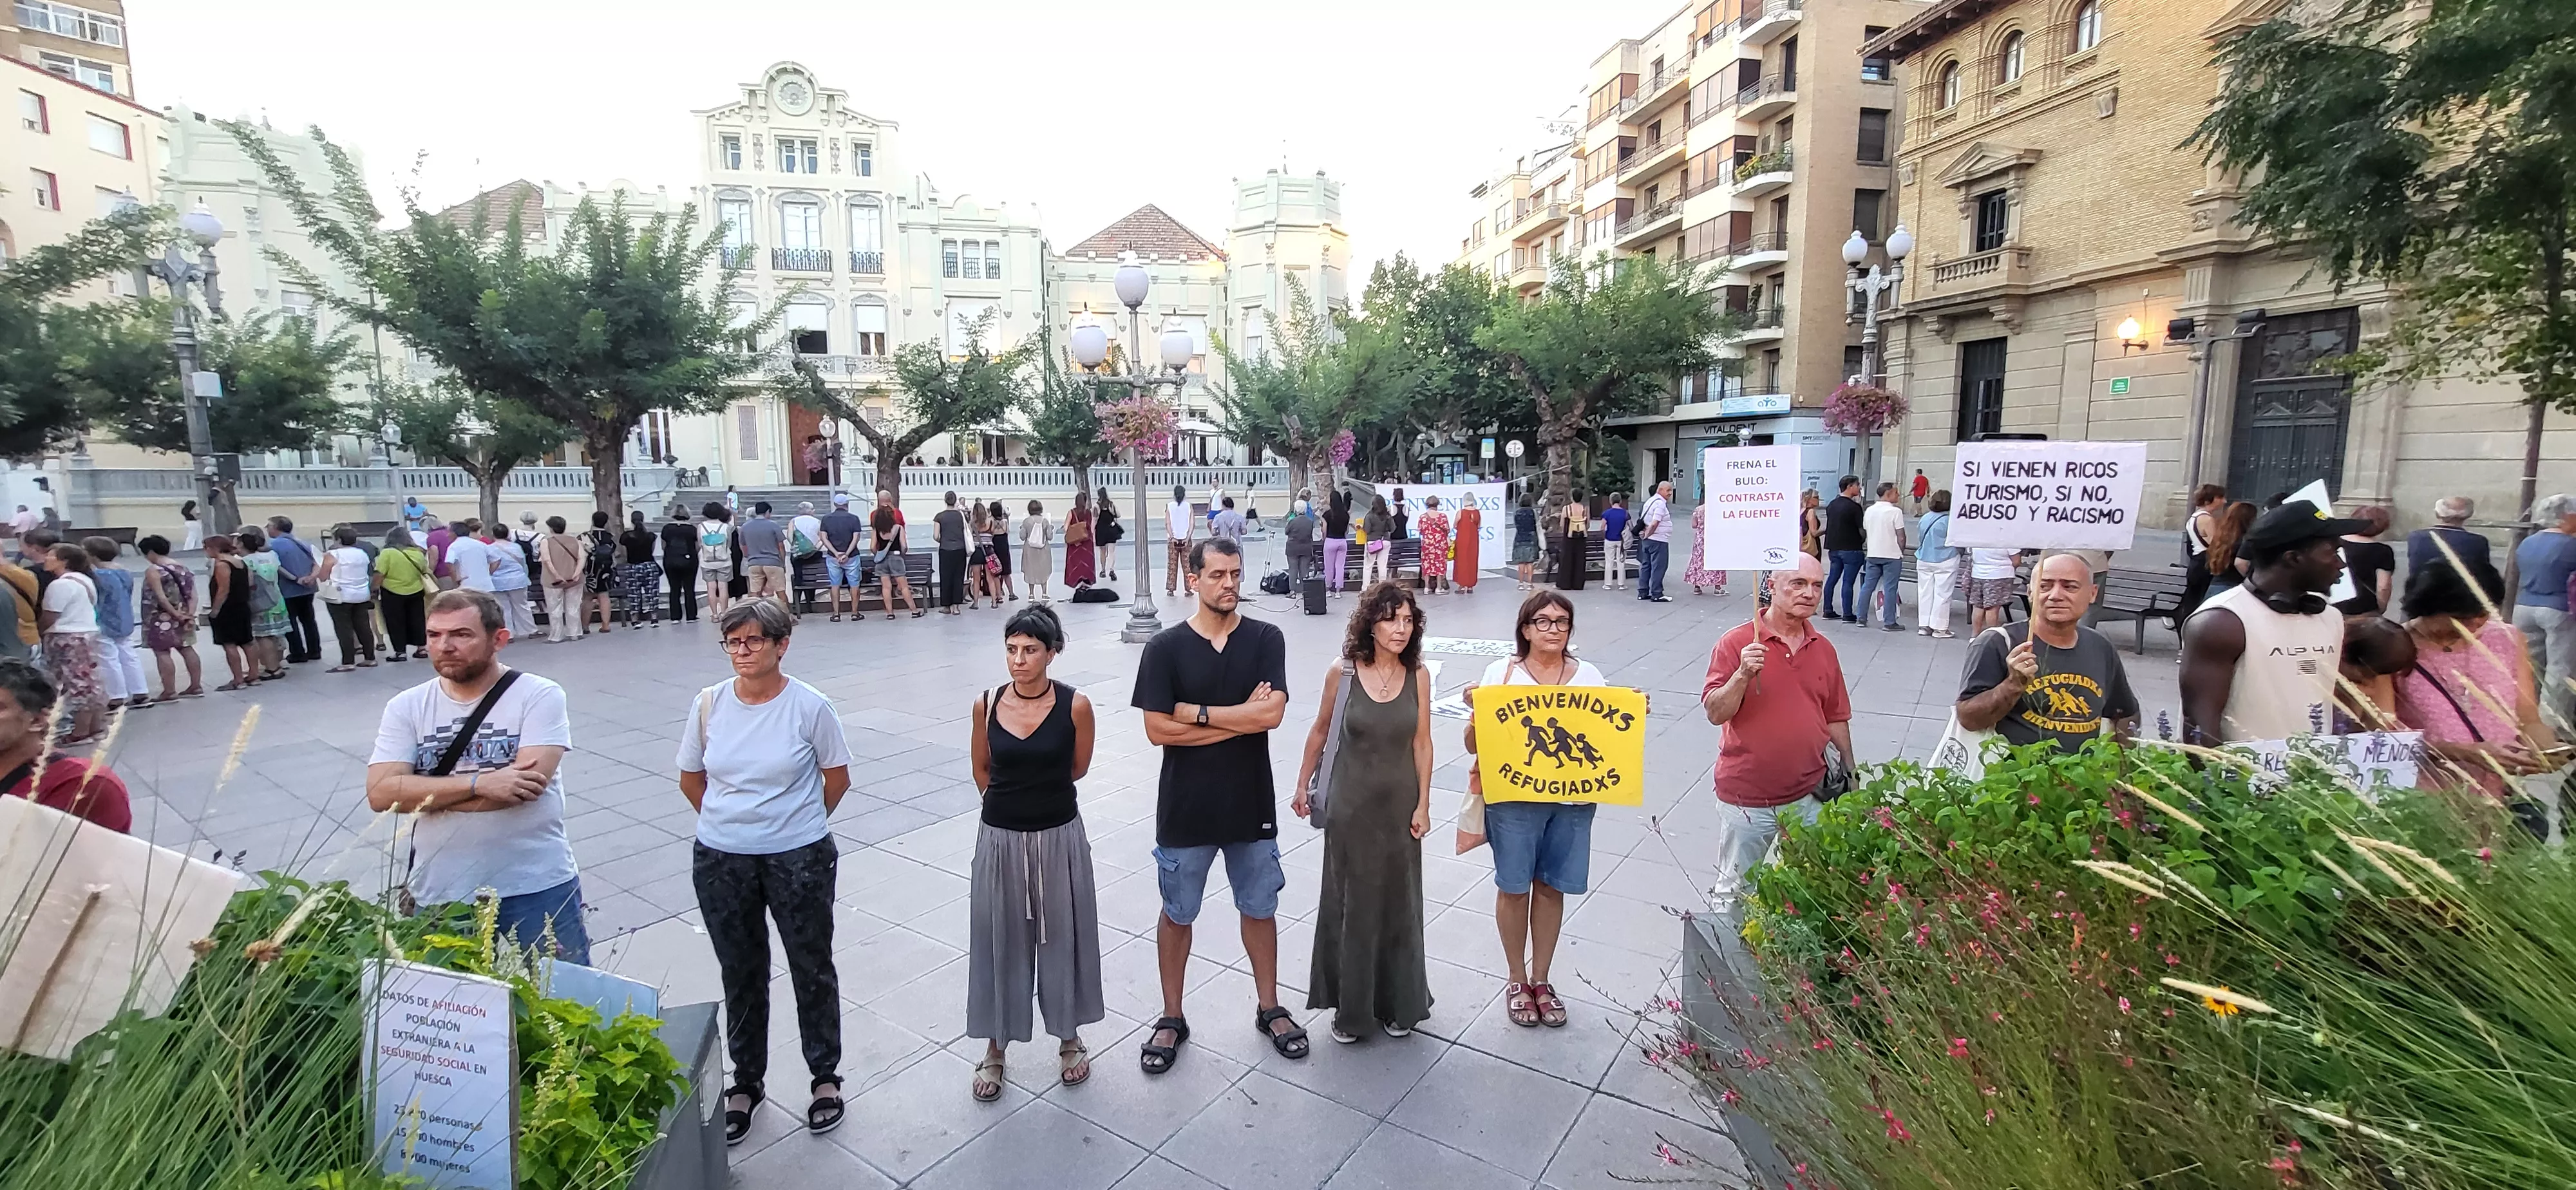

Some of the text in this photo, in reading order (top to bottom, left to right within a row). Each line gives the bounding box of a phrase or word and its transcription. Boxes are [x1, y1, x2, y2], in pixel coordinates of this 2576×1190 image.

[1703, 422, 1757, 434] VITALDENT
[1727, 459, 1777, 469] FRENA EL
[1963, 460, 2118, 478] SI VIENEN RICOS
[1736, 477, 1768, 486] BULO:
[1719, 492, 1784, 502] CONTRASTA
[1965, 484, 2112, 505] TURISMO, SI NO,
[1723, 509, 1780, 518] LA FUENTE
[1957, 503, 2124, 524] ABUSO Y RACISMO
[1495, 692, 1635, 732] BIENVENIDXS
[1499, 763, 1620, 796] REFUGIADXS
[383, 990, 486, 1018] DATOS DE AFILIACIÓN
[406, 1013, 460, 1032] POBLACIÓN
[392, 1029, 475, 1053] EXTRANJERA A LA
[381, 1045, 487, 1075] SEGURIDAD SOCIAL EN
[414, 1071, 452, 1086] HUESCA
[429, 1114, 475, 1129] personas
